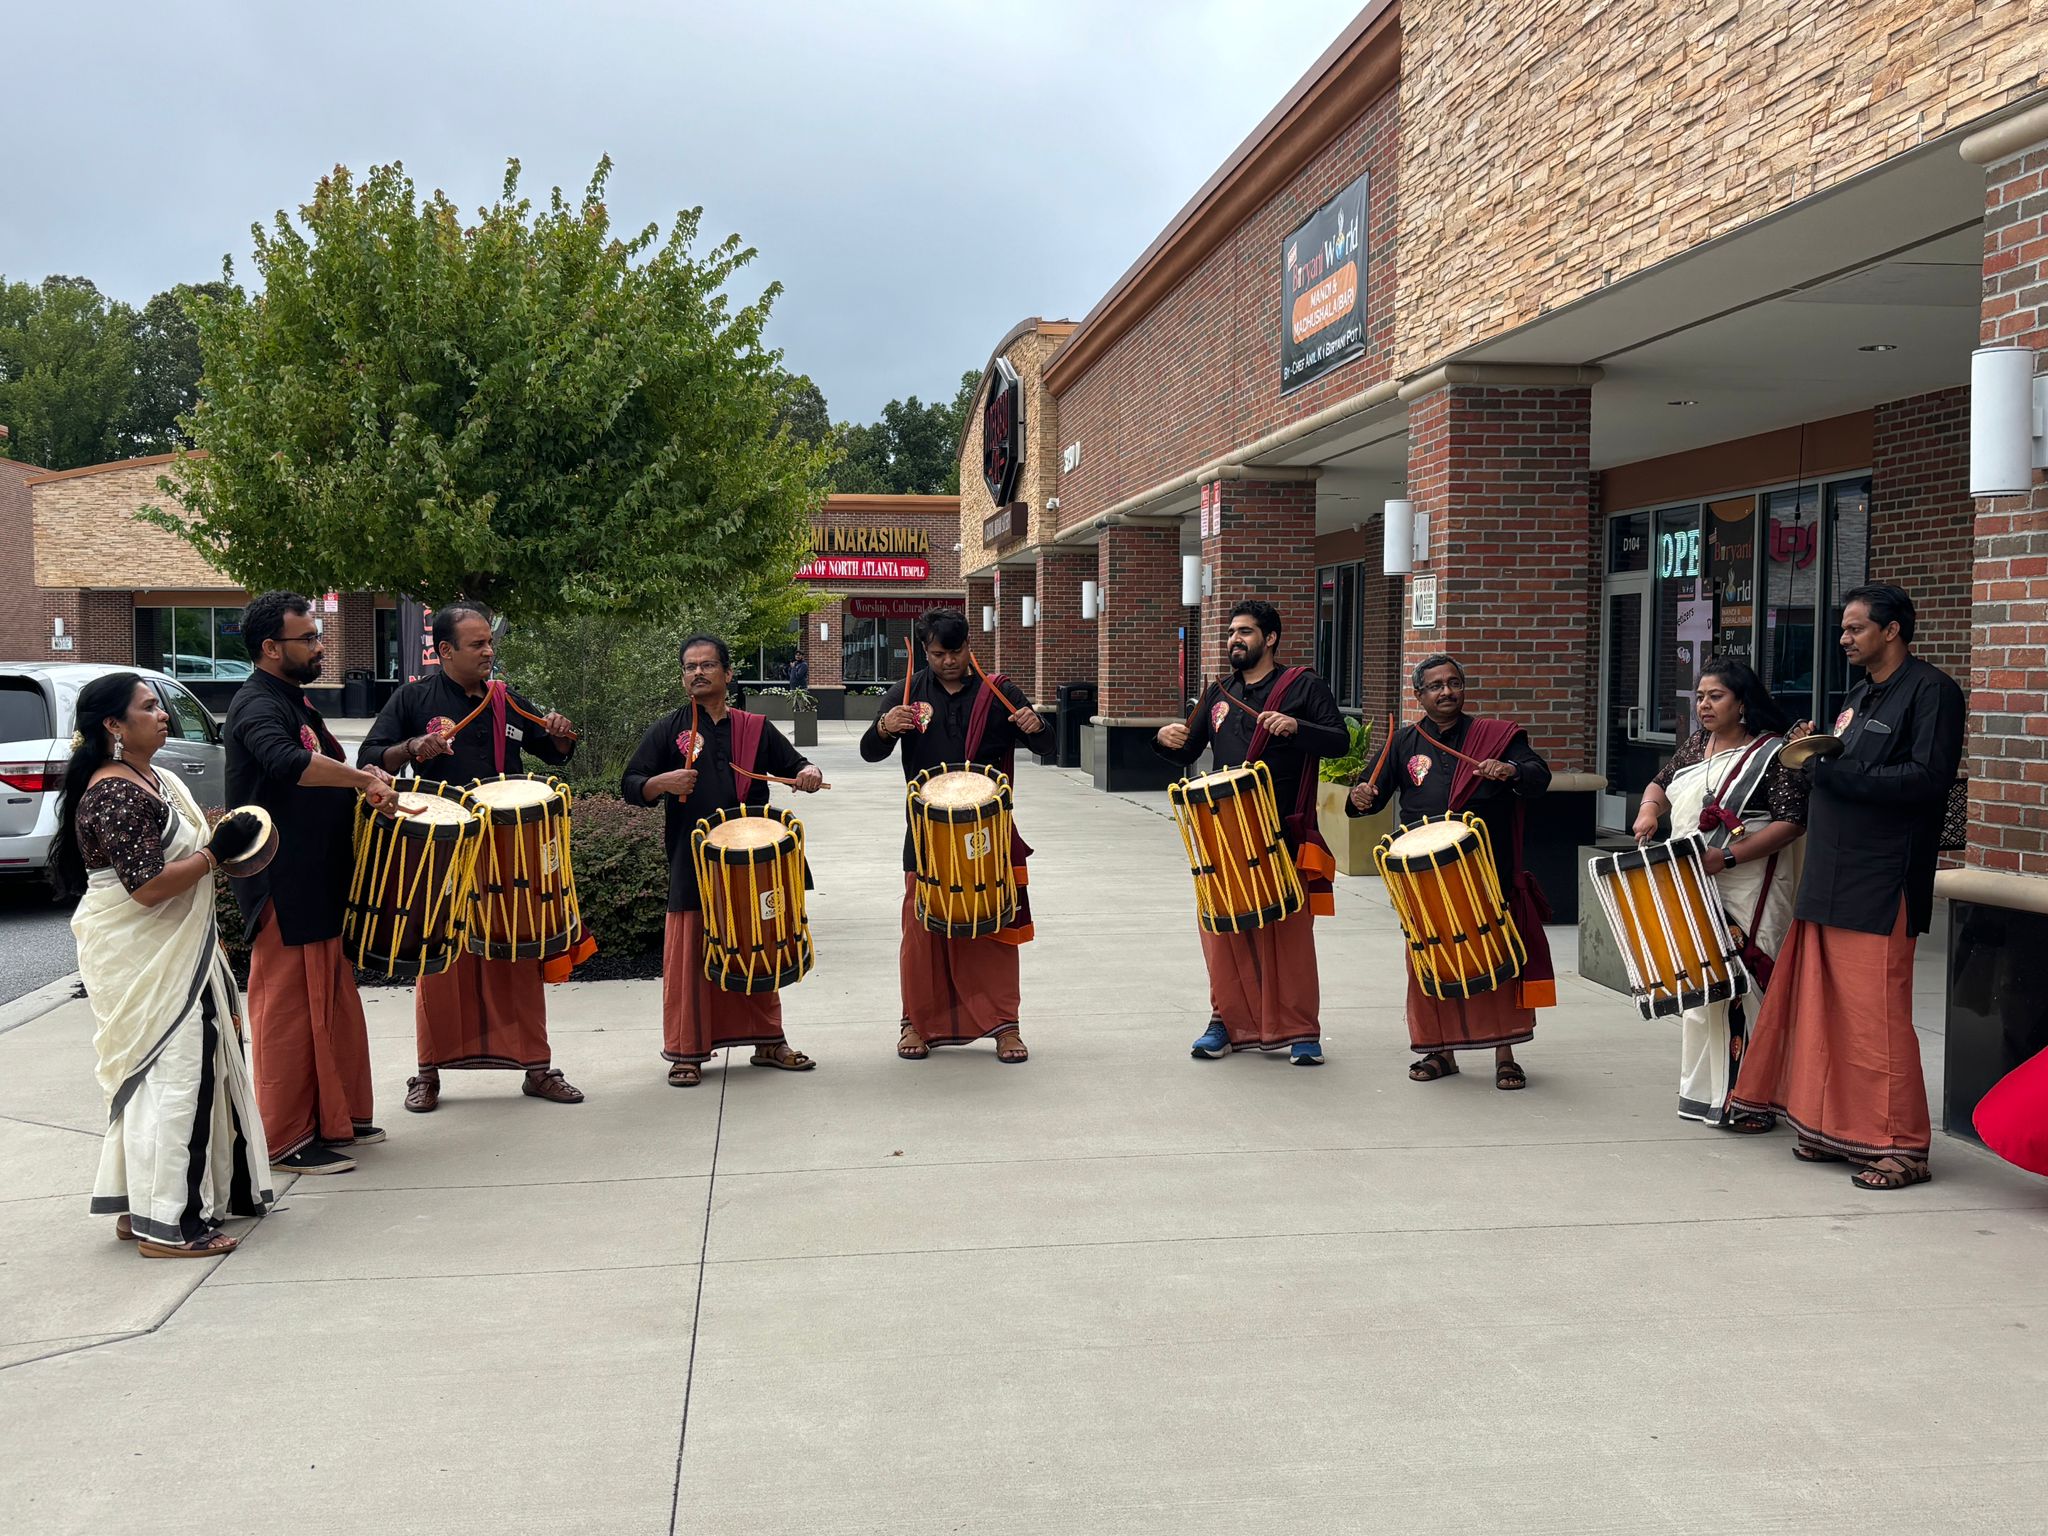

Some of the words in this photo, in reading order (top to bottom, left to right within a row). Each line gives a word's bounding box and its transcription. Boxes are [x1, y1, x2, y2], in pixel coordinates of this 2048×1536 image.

[1310, 282, 1332, 308] MANDI
[811, 526, 829, 551] MI
[834, 526, 930, 552] NARASIMHA
[1623, 536, 1640, 551] D104
[1661, 529, 1700, 578] OPE
[815, 560, 827, 575] OF
[829, 560, 859, 576] NORTH
[861, 561, 899, 577] ATLANTA
[900, 565, 926, 577] TEMPLE
[855, 600, 890, 616] Worship,
[893, 600, 925, 613] Cultural
[1726, 630, 1735, 640] BY
[1728, 643, 1745, 655] ANIL
